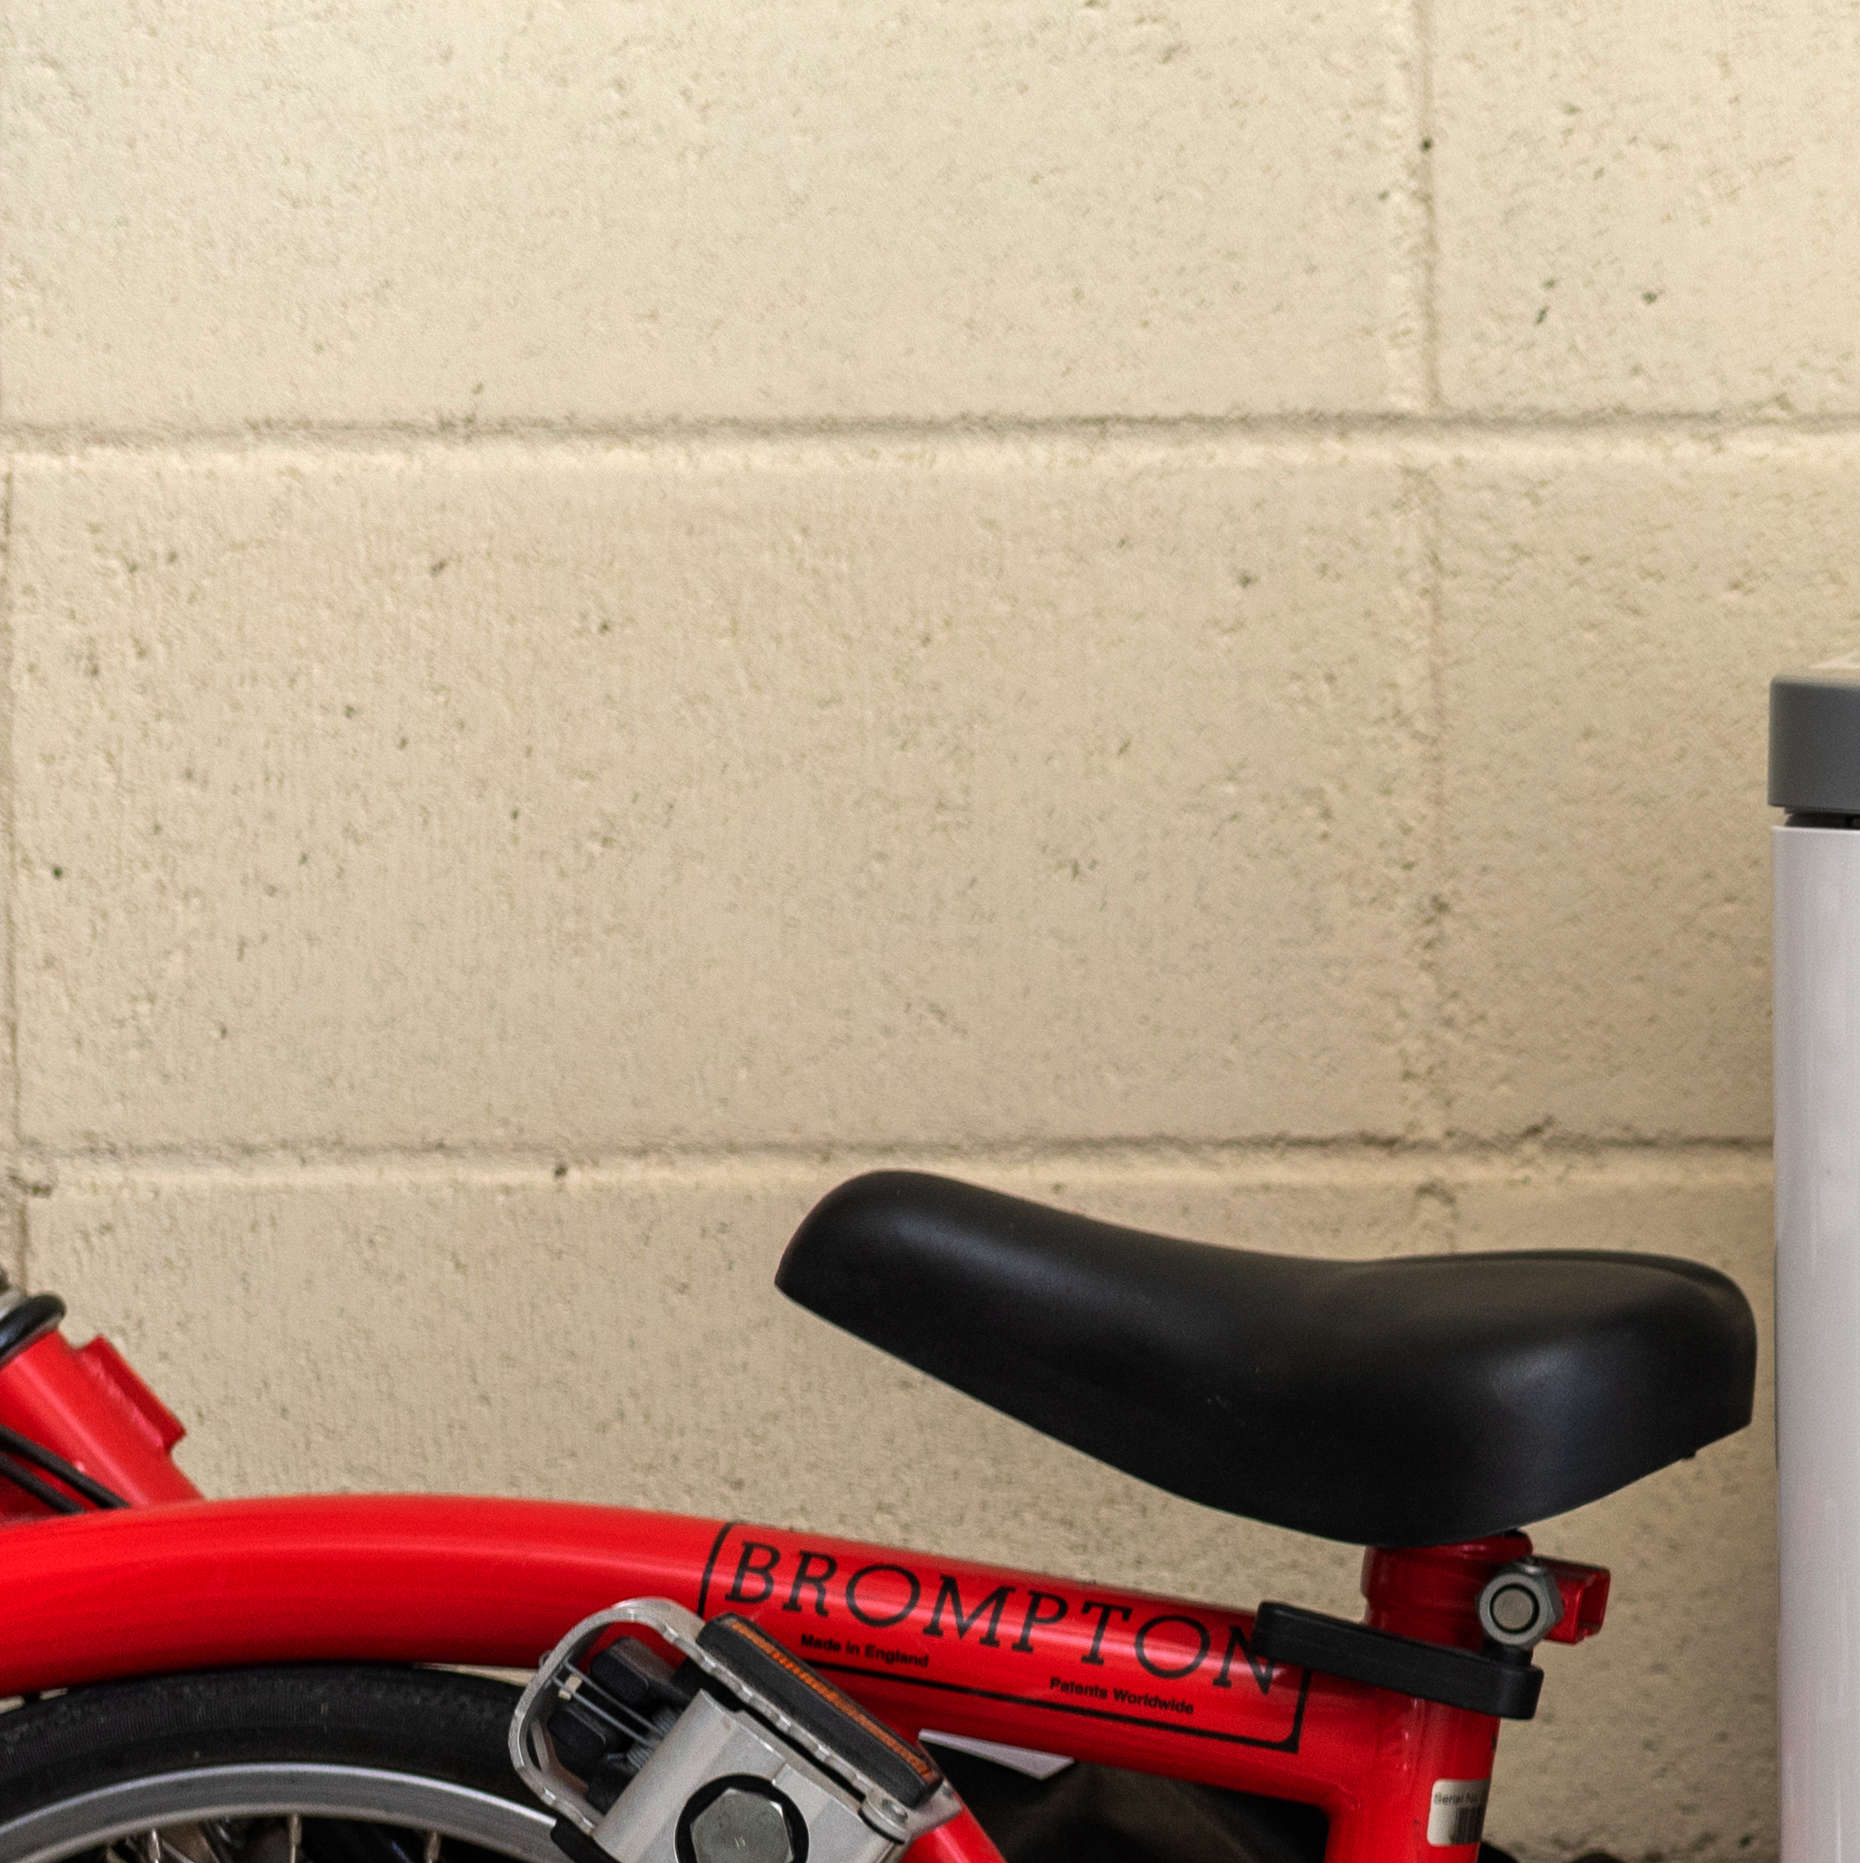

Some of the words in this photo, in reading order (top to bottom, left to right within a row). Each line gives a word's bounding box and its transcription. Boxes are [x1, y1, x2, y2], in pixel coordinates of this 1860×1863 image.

[725, 1541, 1278, 1695] BROMPTON
[801, 1633, 842, 1652] Made
[846, 1640, 861, 1655] in
[865, 1644, 930, 1668] England
[1050, 1677, 1108, 1699] Patents
[1113, 1688, 1194, 1714] Worldwide
